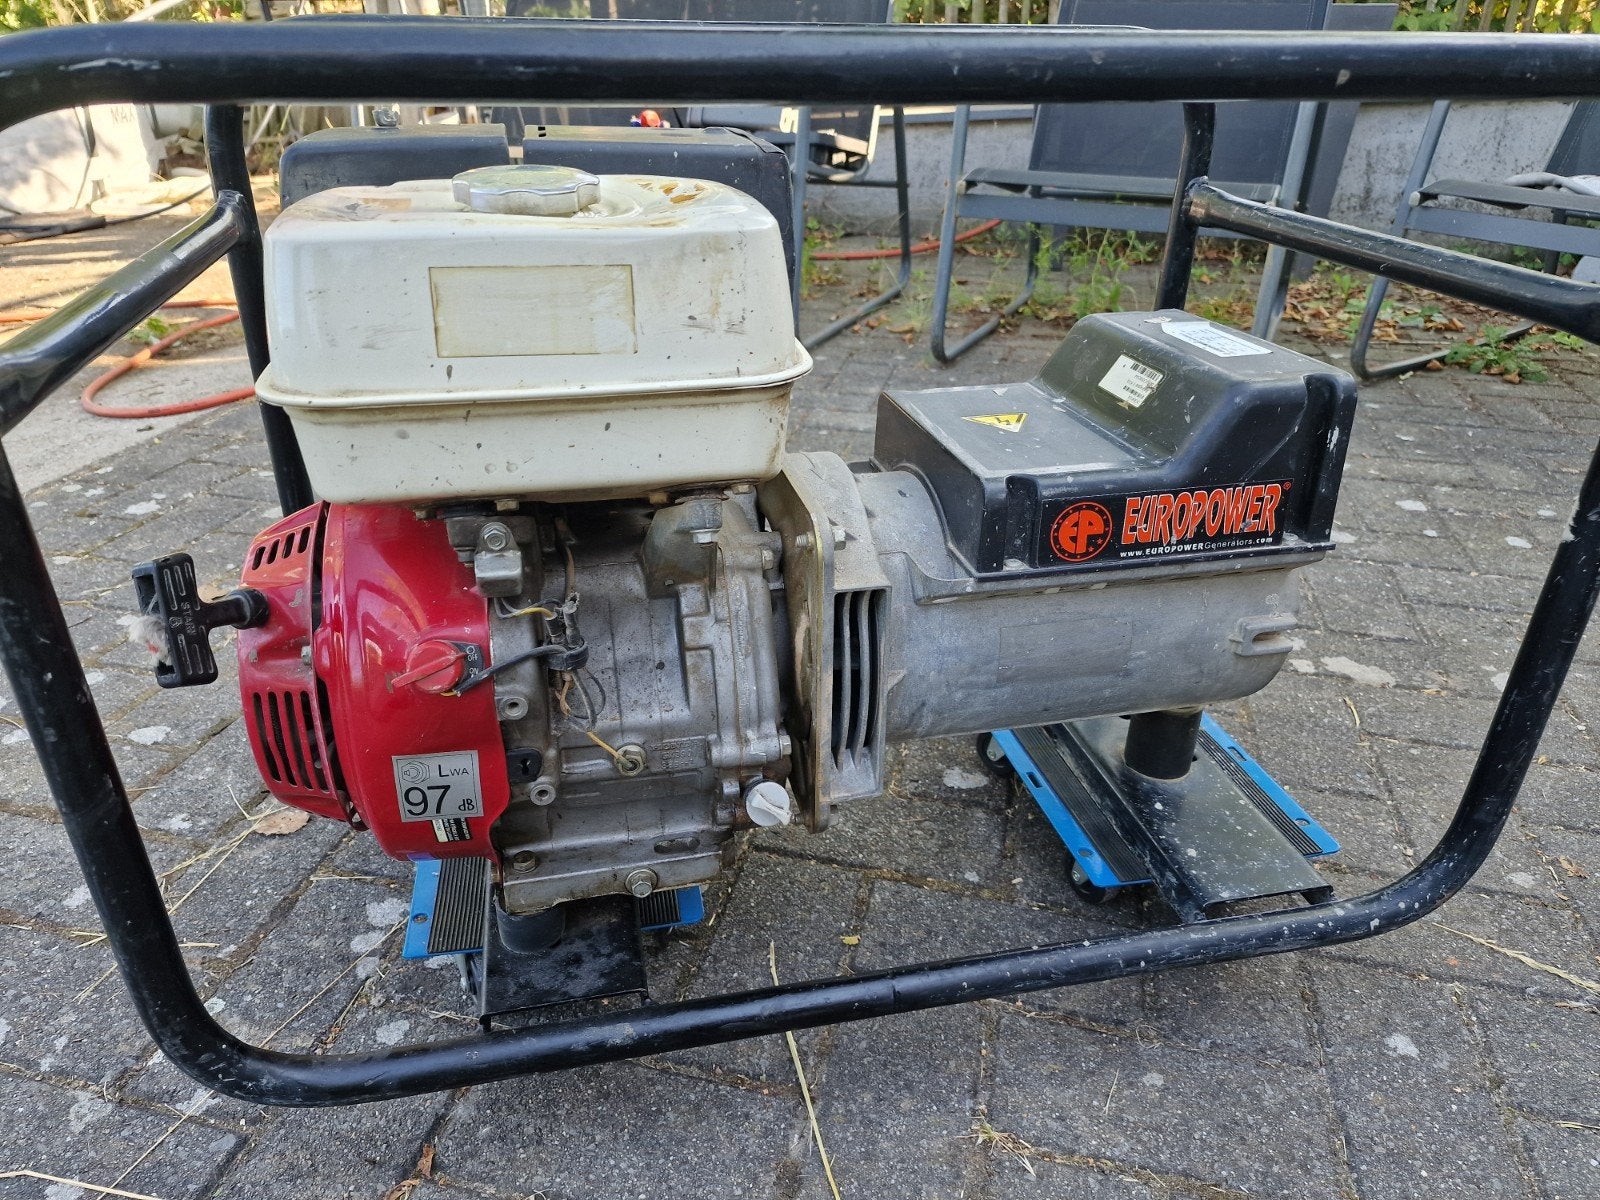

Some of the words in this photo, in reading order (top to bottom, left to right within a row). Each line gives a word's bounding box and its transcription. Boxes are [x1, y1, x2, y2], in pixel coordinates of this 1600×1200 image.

[1121, 484, 1282, 546] EUROPOWER
[1119, 537, 1273, 558] www.EUROPOWERGenerators.com
[403, 784, 451, 817] 97
[458, 798, 475, 812] dB
